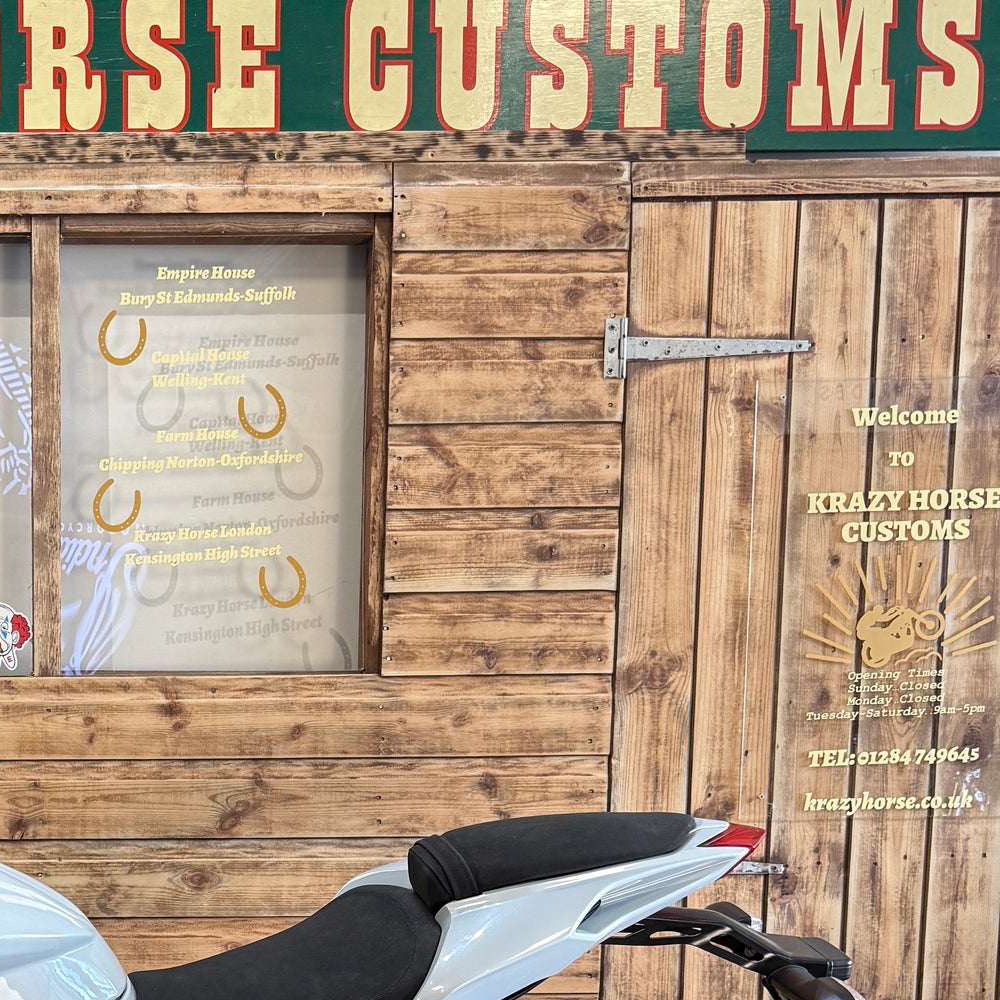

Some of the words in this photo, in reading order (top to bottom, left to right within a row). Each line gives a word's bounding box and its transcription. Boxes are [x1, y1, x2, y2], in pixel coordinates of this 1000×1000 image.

[342, 0, 985, 133] CUSTOMS
[156, 265, 209, 284] Empire
[211, 265, 256, 280] House
[119, 291, 156, 308] Bury
[156, 290, 173, 304] St
[173, 286, 297, 305] Edmunds-Suffolk
[151, 348, 204, 368] Capital
[207, 348, 250, 363] House
[151, 372, 247, 390] Welling-Kent
[851, 404, 960, 427] Welcome
[155, 428, 195, 443] Farm
[196, 427, 240, 441] House
[99, 455, 165, 475] Chipping
[165, 450, 303, 469] Norton-Oxfordshire
[888, 451, 915, 467] TO
[807, 490, 904, 514] KRAZY
[907, 488, 1000, 511] HORSE
[133, 526, 177, 544] Krazy
[178, 525, 219, 541] Horse
[220, 522, 273, 539] London
[841, 518, 971, 543] CUSTOMS
[124, 549, 205, 567] Kensington
[205, 545, 239, 564] High
[240, 543, 283, 558] Street
[847, 670, 901, 682] Opening
[908, 668, 945, 678] Times
[914, 746, 980, 766] 749645
[803, 789, 974, 816] krazyhorse.co.uk
